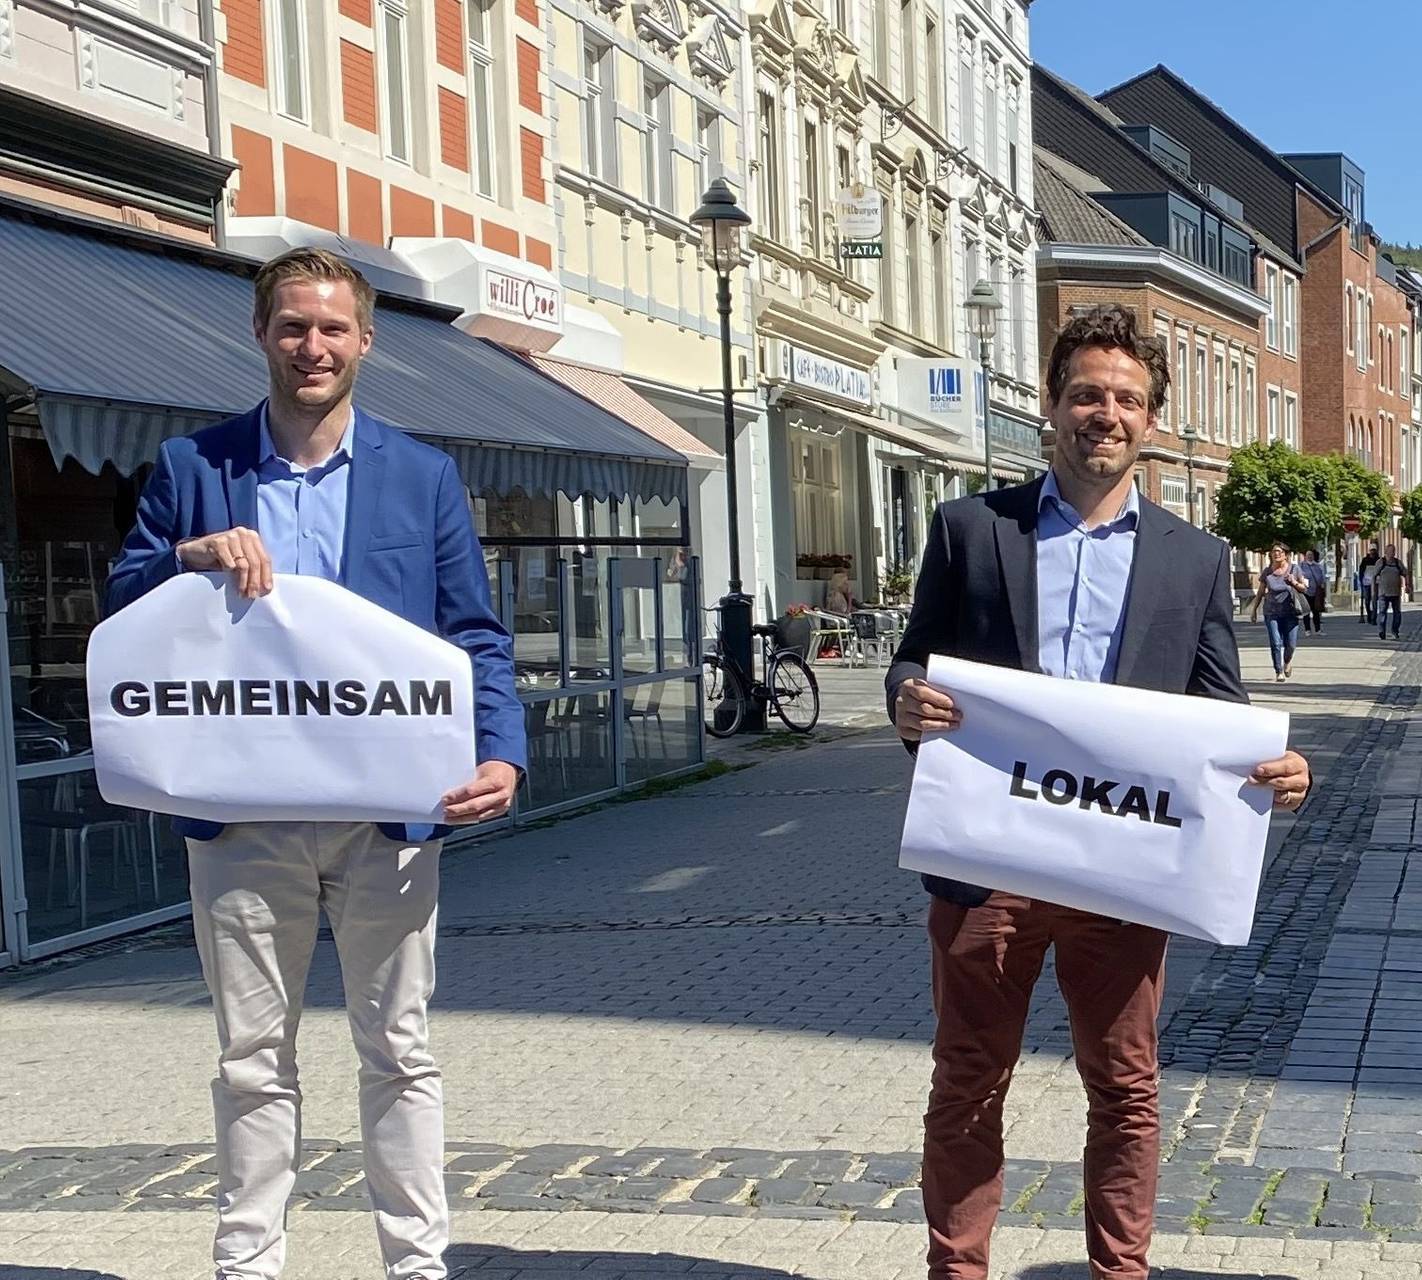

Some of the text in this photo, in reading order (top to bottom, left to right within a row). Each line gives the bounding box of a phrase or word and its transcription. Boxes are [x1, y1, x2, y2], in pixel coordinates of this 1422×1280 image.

[841, 245, 881, 256] PLATIA
[489, 278, 519, 307] willi
[523, 280, 555, 320] Croé
[834, 365, 864, 398] PLATIA
[110, 680, 453, 717] GEMEINSAM
[1010, 760, 1182, 828] LOKAL
